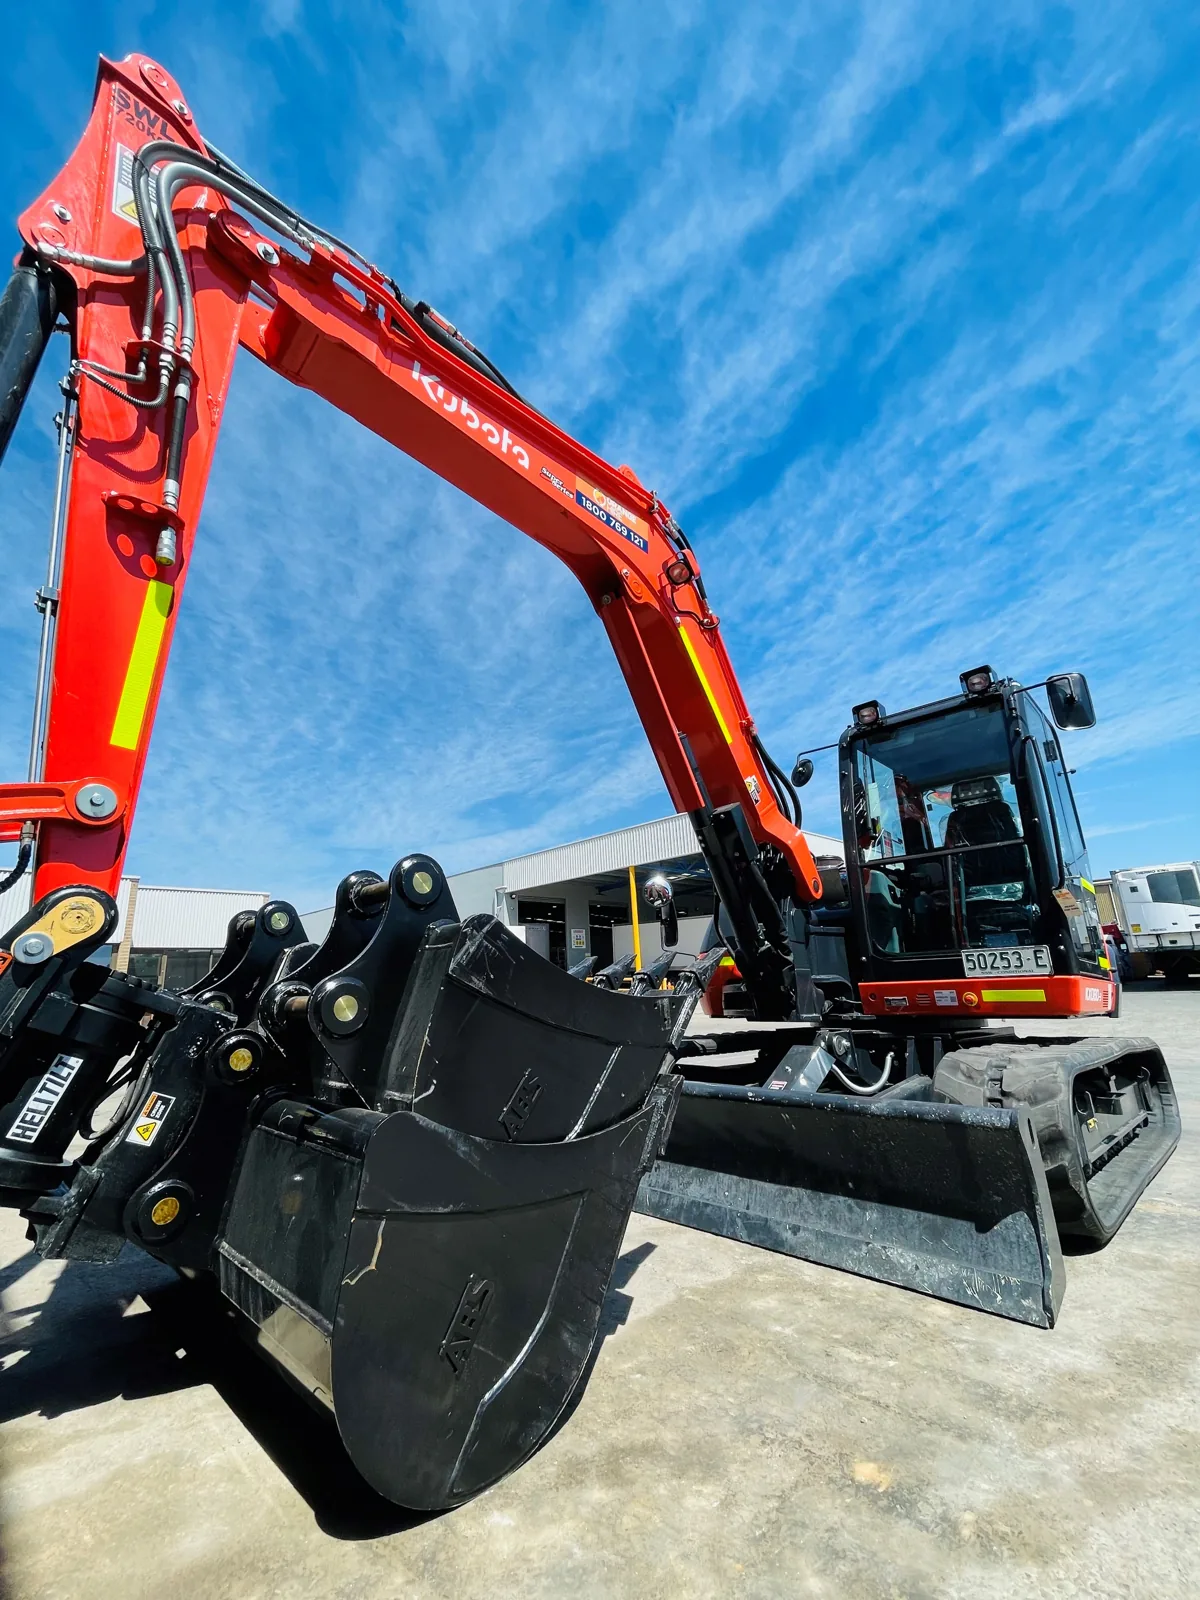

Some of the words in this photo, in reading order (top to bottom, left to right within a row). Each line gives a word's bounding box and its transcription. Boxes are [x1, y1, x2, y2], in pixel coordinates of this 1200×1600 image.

[115, 88, 175, 142] SWL
[412, 360, 530, 470] Kubota
[581, 496, 607, 521] 1800
[609, 516, 628, 536] 769
[629, 531, 644, 548] 121
[11, 1056, 75, 1140] HELITILT
